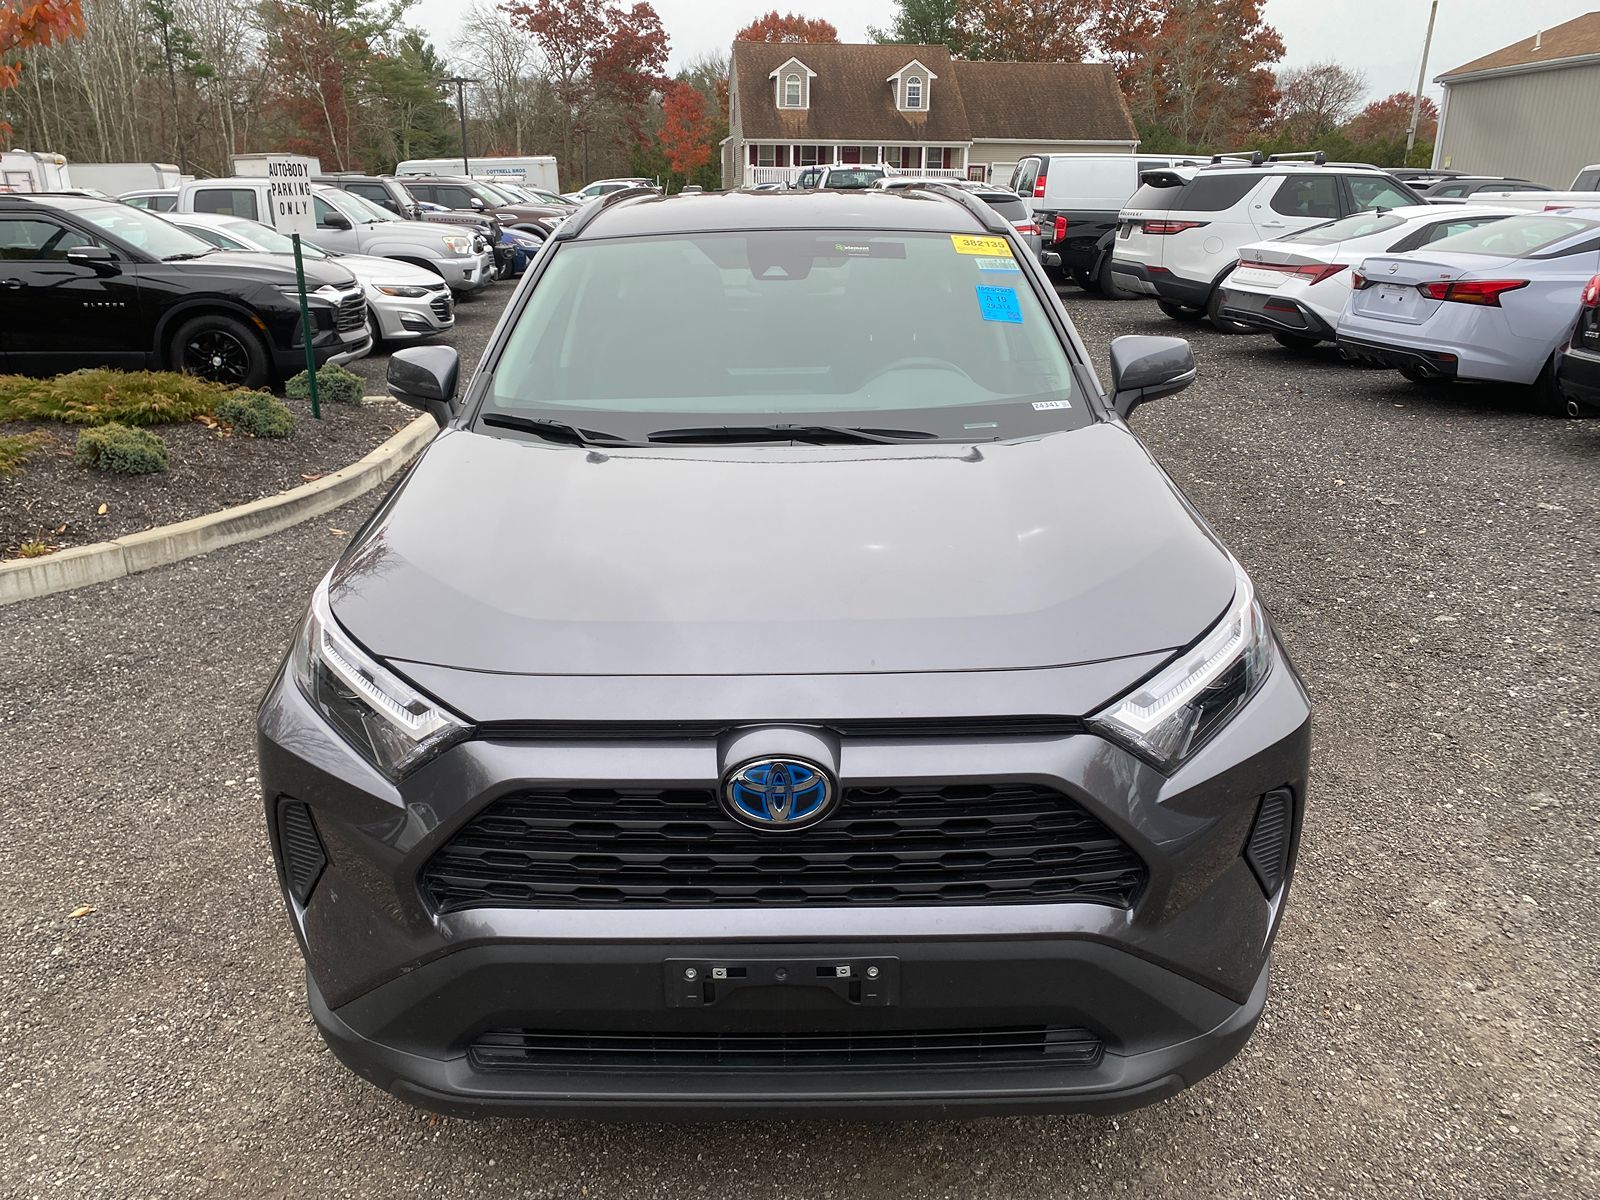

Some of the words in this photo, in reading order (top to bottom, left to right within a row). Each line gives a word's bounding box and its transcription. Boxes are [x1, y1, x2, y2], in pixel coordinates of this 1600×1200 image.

[271, 183, 311, 196] PARKING
[280, 201, 307, 215] ONLY
[962, 239, 1005, 249] 382135
